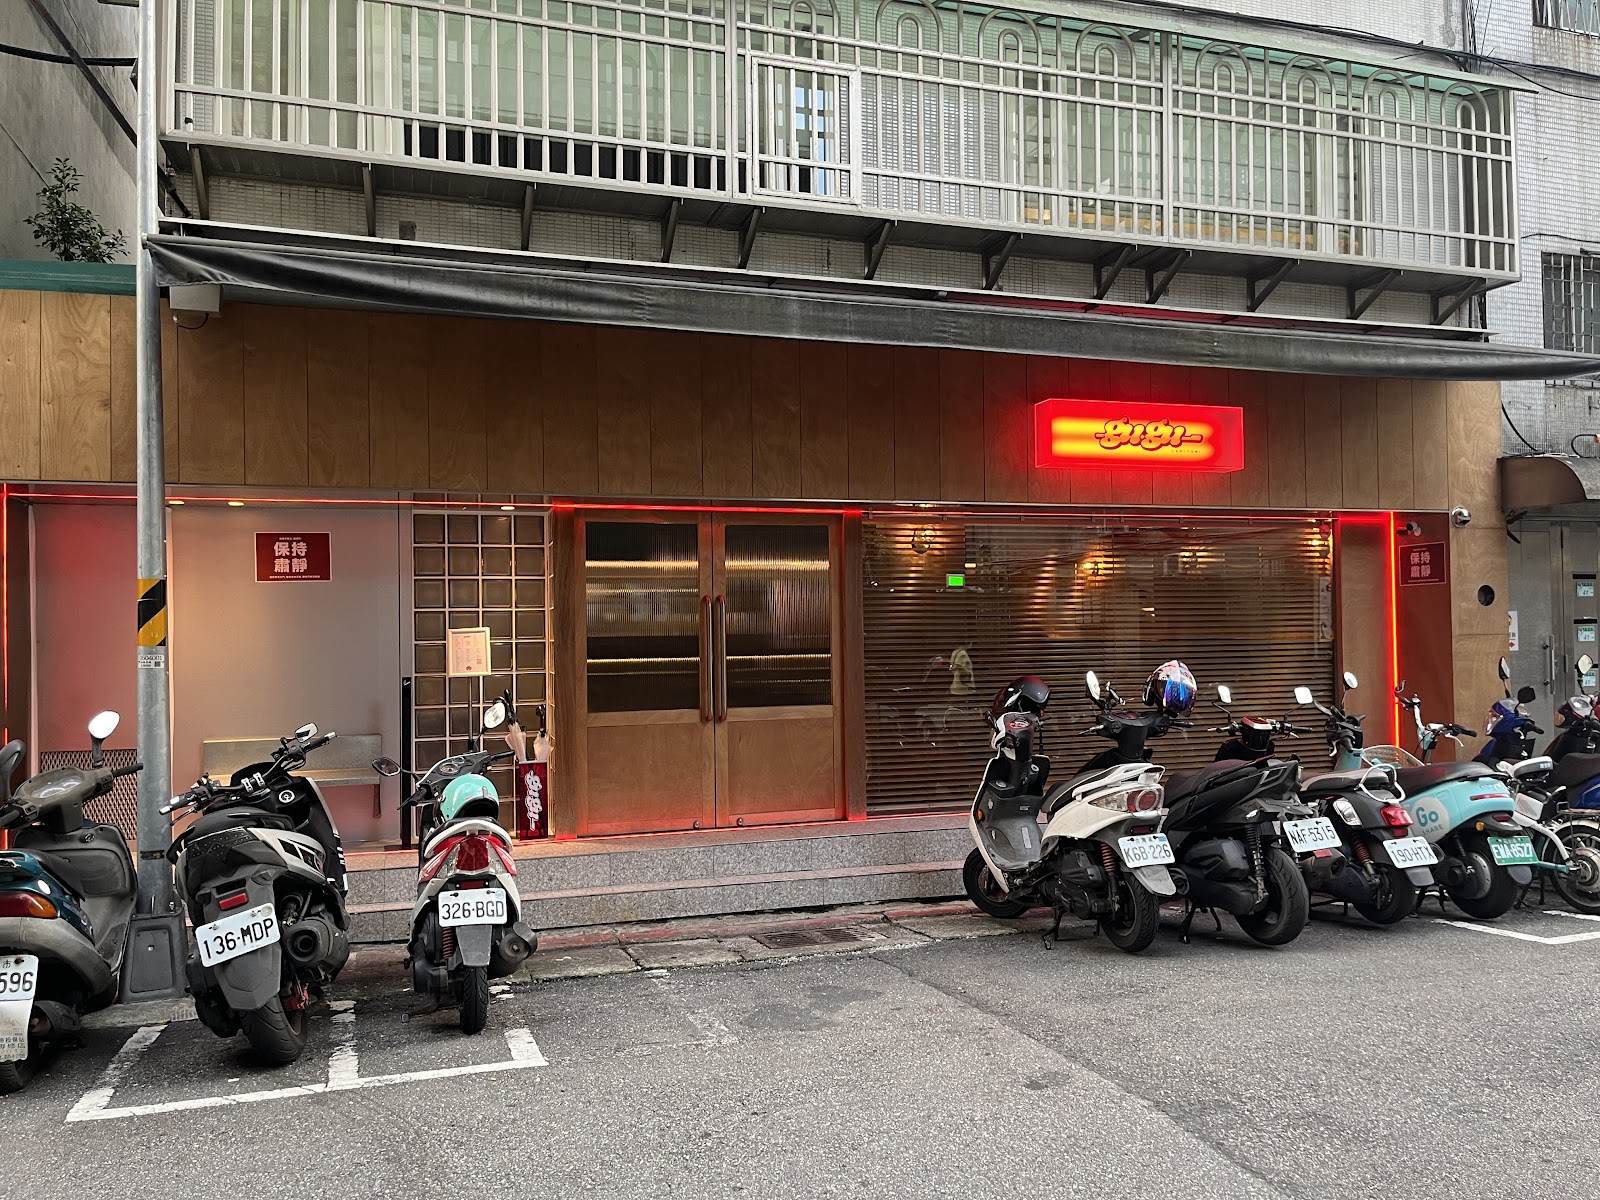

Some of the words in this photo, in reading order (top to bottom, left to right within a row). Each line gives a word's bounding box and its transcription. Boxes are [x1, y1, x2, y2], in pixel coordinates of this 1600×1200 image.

[273, 541, 308, 556] 保持
[273, 558, 308, 573] 肅靜
[1410, 551, 1430, 565] 保持
[1415, 806, 1439, 827] Go
[1422, 823, 1444, 836] SHARE
